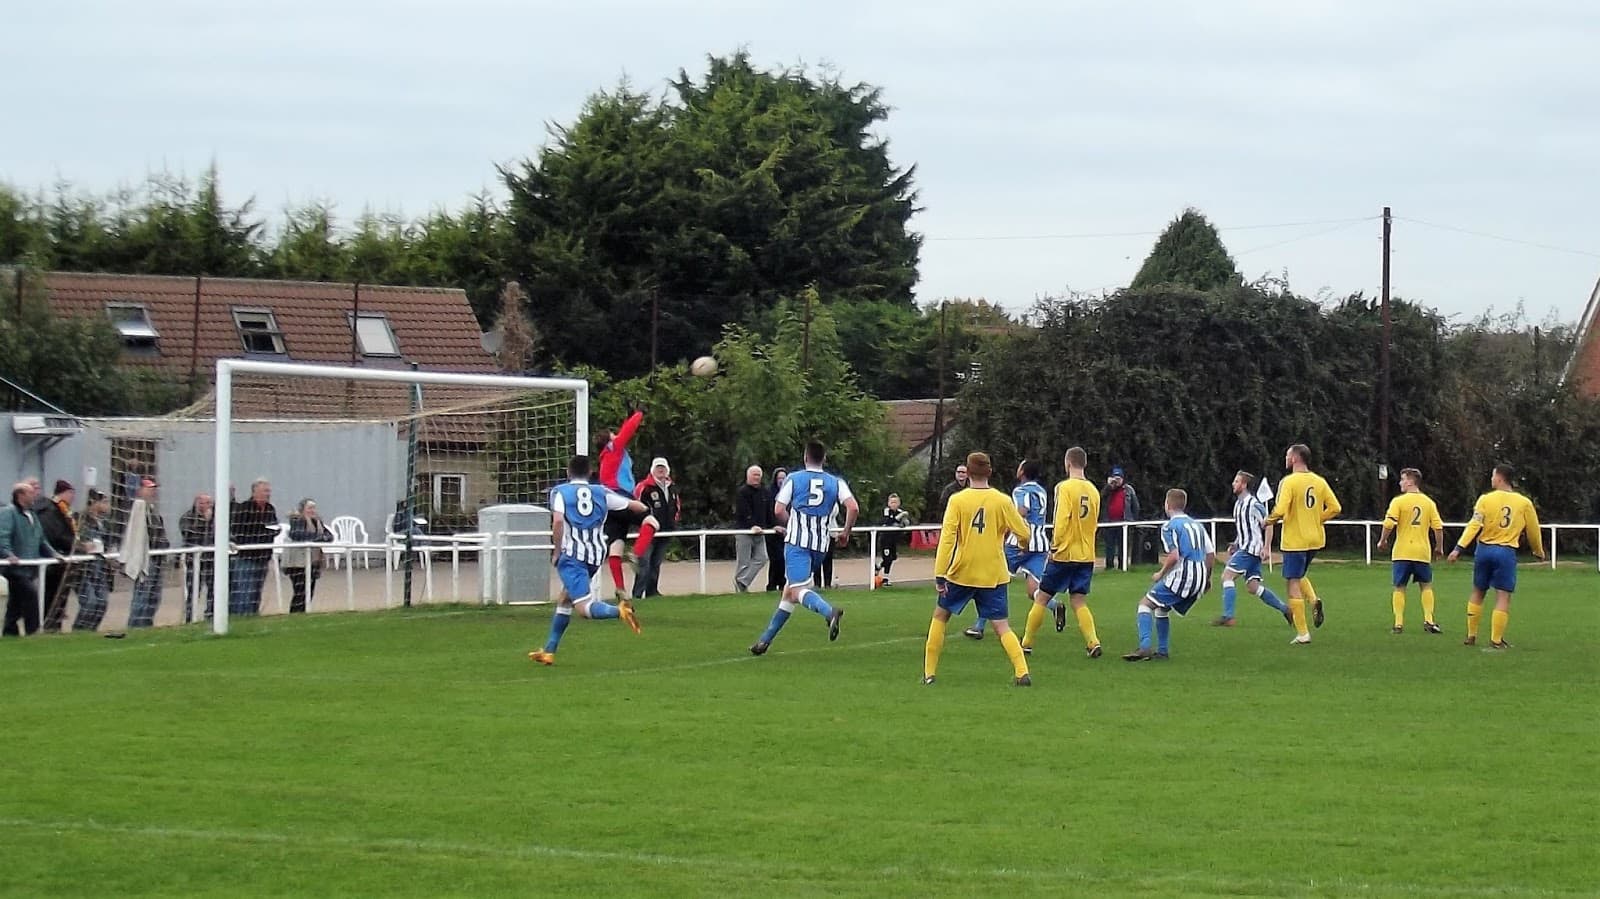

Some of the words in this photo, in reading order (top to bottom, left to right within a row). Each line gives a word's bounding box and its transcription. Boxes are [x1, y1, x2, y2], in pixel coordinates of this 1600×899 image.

[576, 487, 593, 516] 8
[808, 479, 824, 506] 5
[1305, 486, 1315, 508] 6
[1079, 496, 1089, 519] 5
[1411, 506, 1422, 526] 2
[1499, 506, 1512, 528] 3
[972, 507, 986, 534] 4
[1183, 522, 1201, 550] 11
